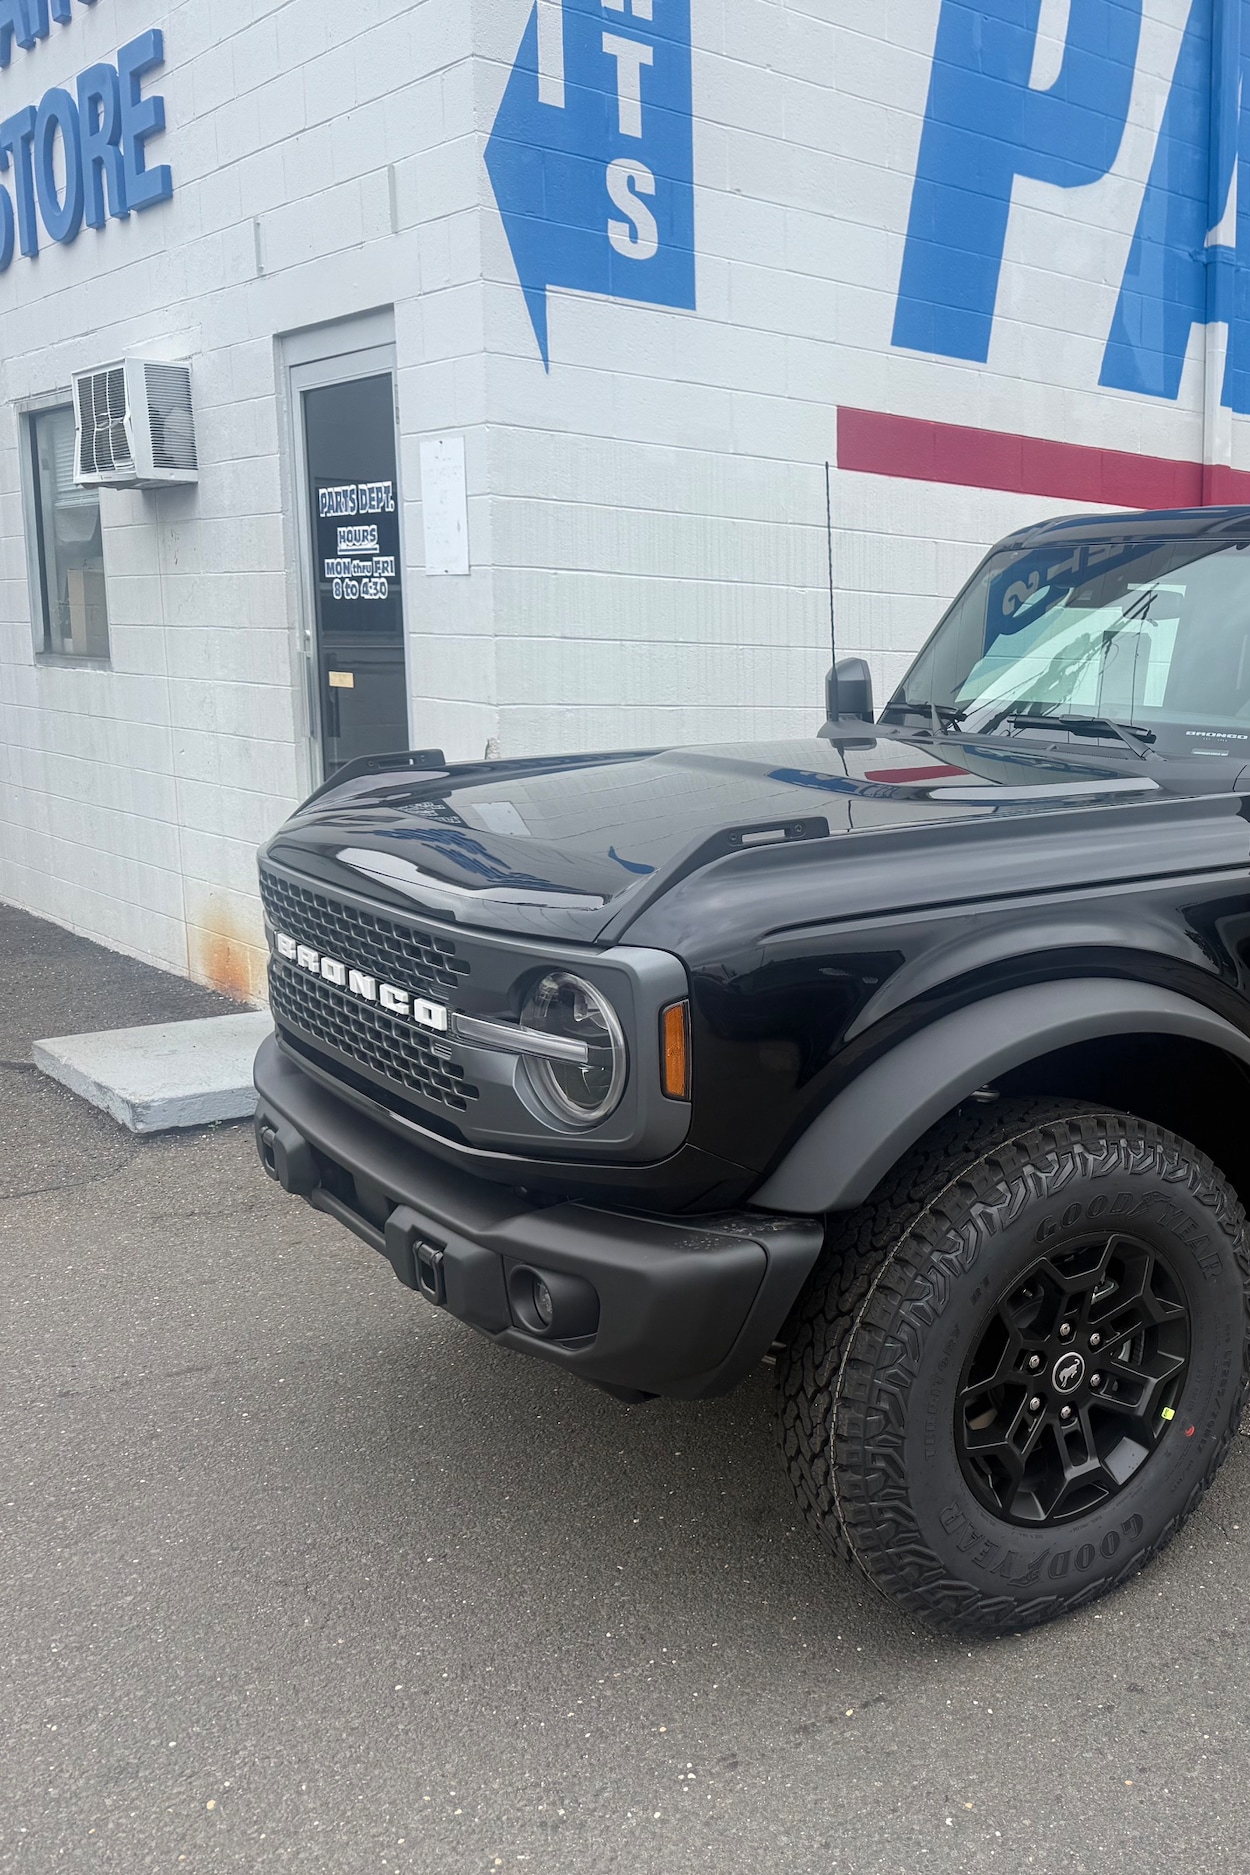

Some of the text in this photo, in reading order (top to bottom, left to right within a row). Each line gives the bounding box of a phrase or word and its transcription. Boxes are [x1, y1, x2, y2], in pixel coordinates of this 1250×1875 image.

[602, 0, 659, 261] TS
[319, 480, 395, 517] PARTS DEPT.
[337, 525, 378, 547] HOURS
[325, 556, 395, 577] MON thru FRI
[332, 578, 388, 599] 8 to 4:30
[1185, 731, 1249, 740] BRONCO
[277, 932, 448, 1031] BRONCO
[1035, 1191, 1224, 1281] GOODYEAR
[938, 1500, 1144, 1583] GOODYEAR
